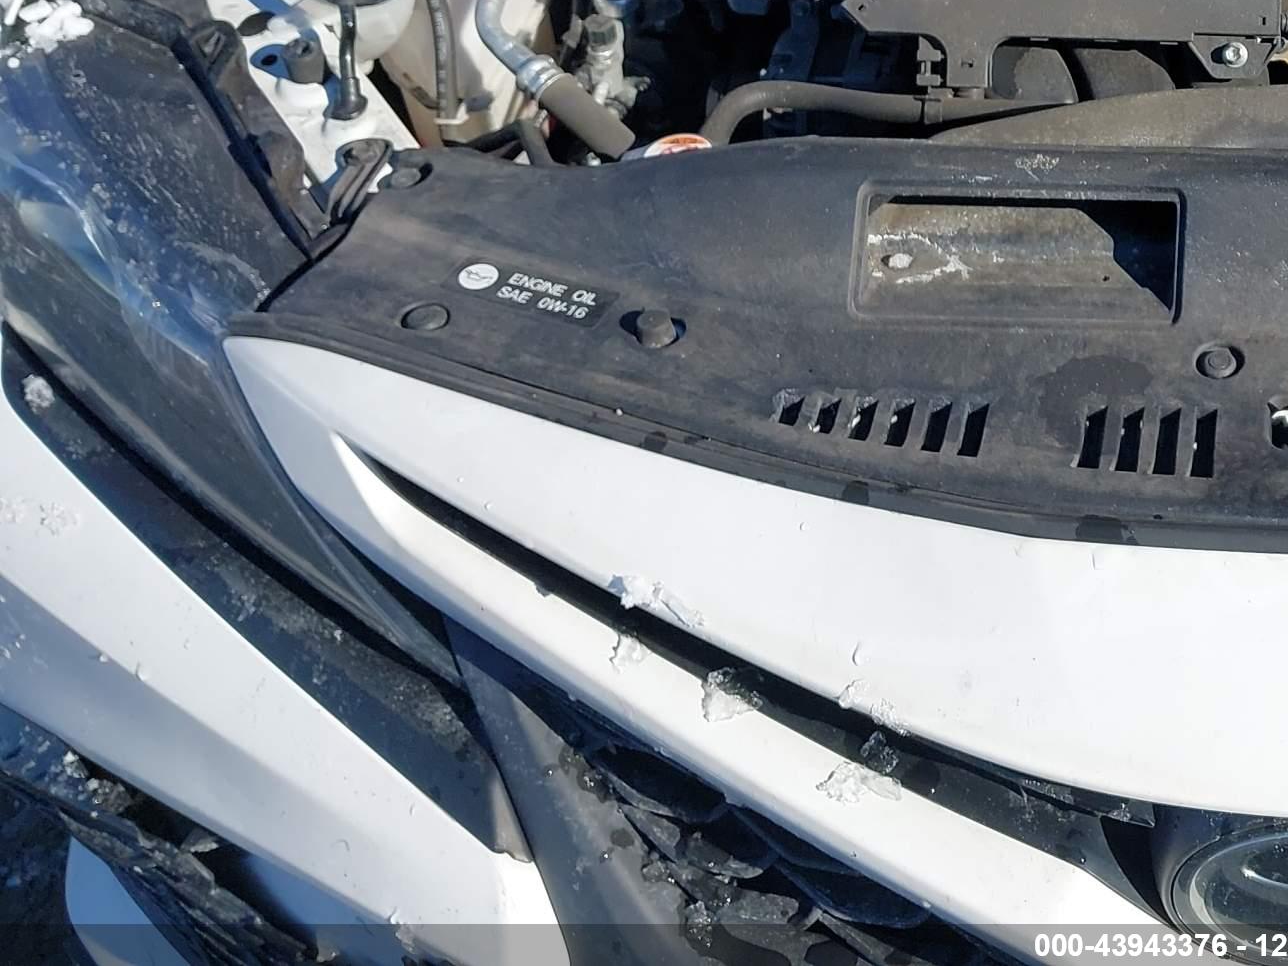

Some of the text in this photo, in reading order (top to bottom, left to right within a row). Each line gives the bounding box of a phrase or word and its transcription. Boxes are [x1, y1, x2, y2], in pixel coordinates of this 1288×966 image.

[496, 286, 588, 319] SAE 0W-16
[509, 272, 598, 305] ENGINE OIL
